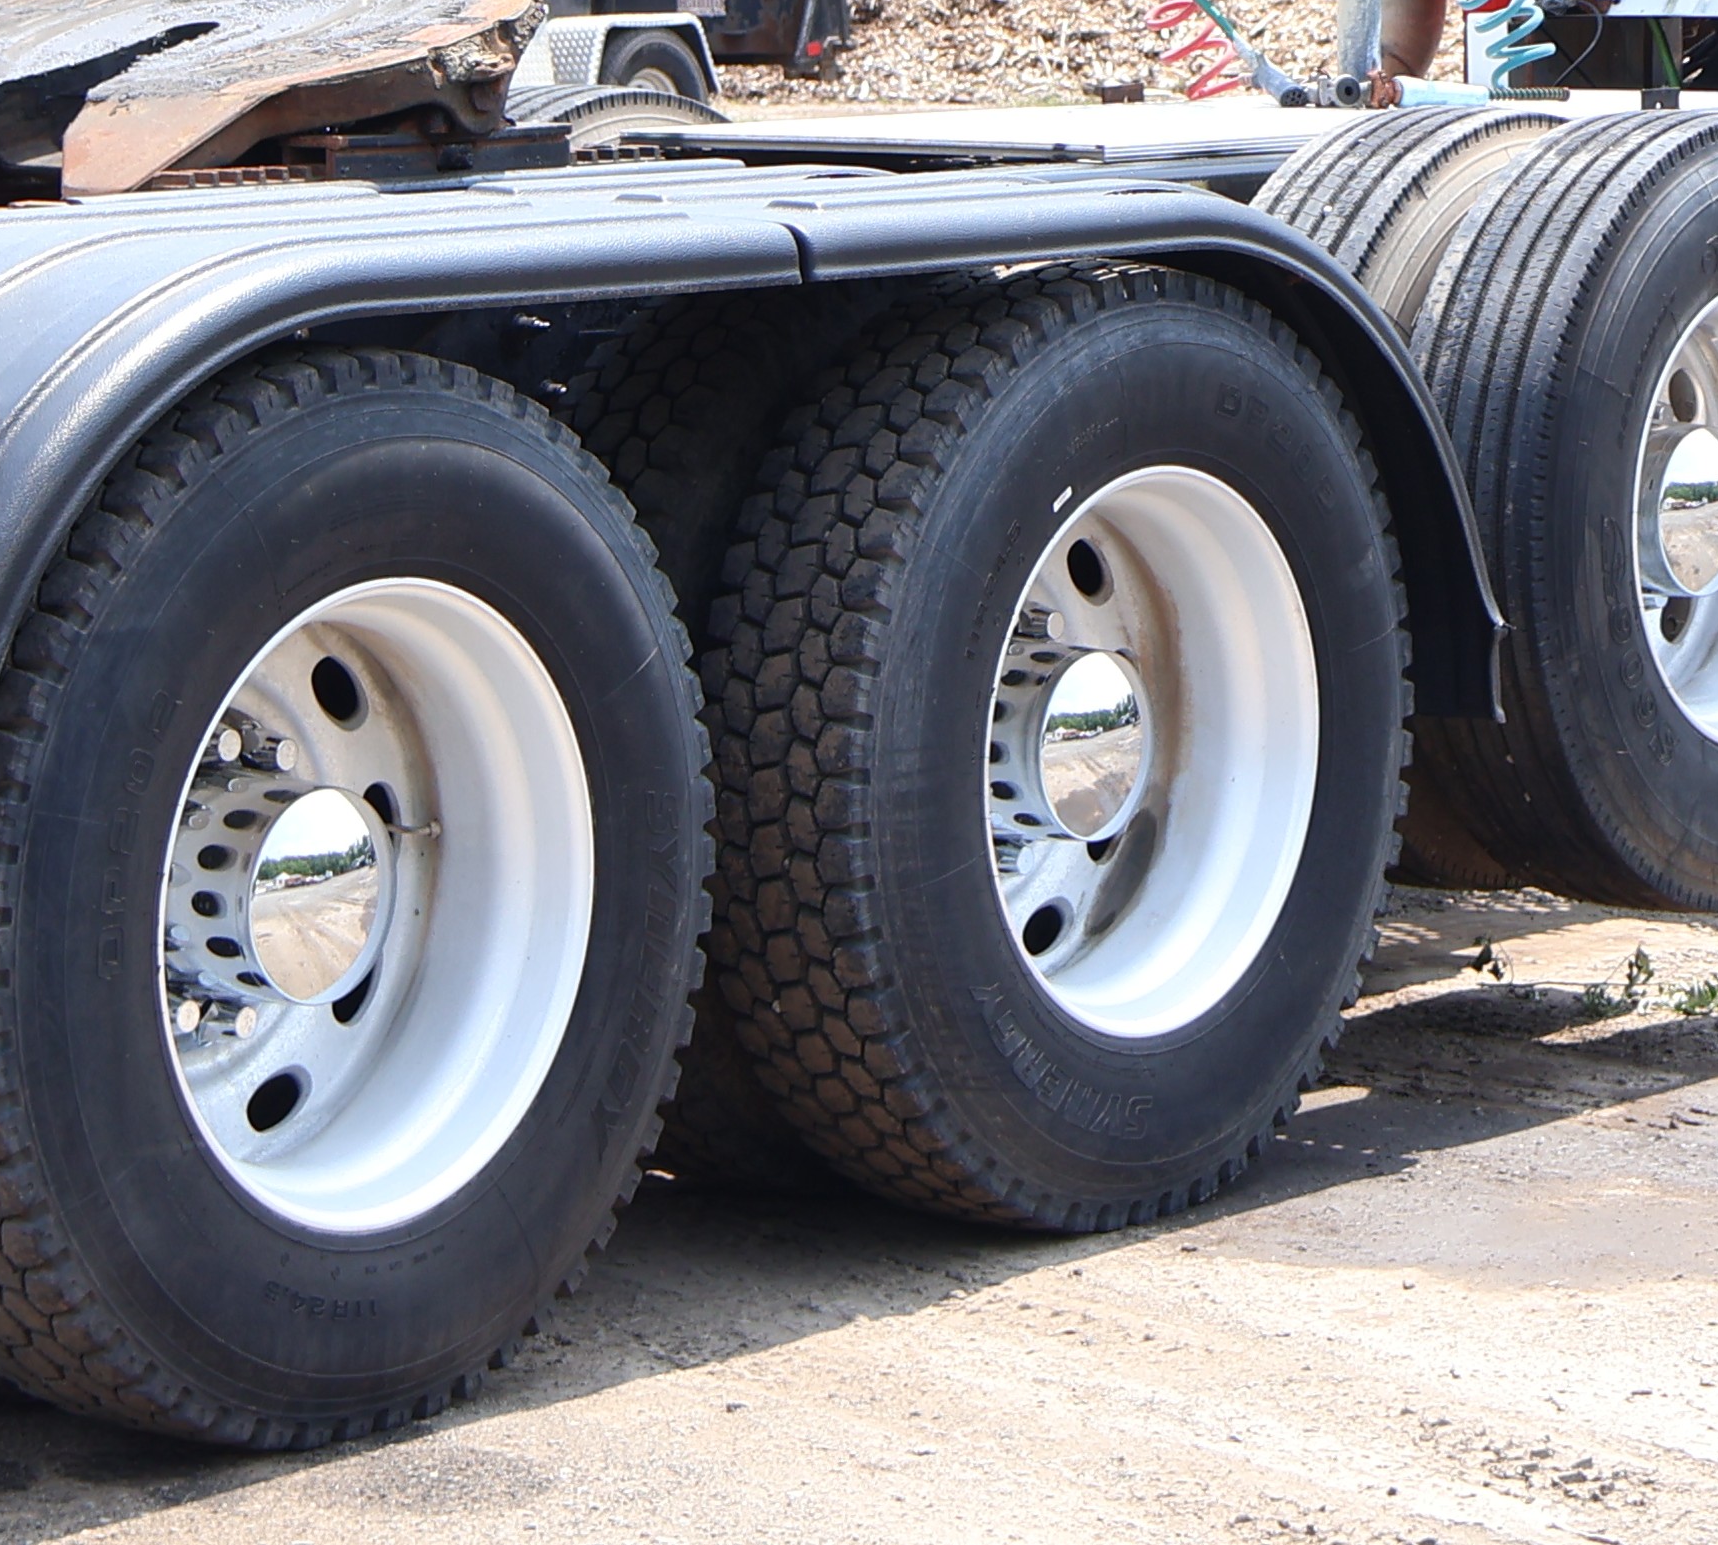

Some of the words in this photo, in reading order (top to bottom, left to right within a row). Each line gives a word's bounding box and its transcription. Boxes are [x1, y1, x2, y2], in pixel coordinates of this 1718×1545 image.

[94, 686, 184, 980] DP202
[589, 788, 680, 1165] SYNERGY
[968, 981, 1154, 1141] SYNERGY
[263, 1280, 378, 1321] 11R24.5
